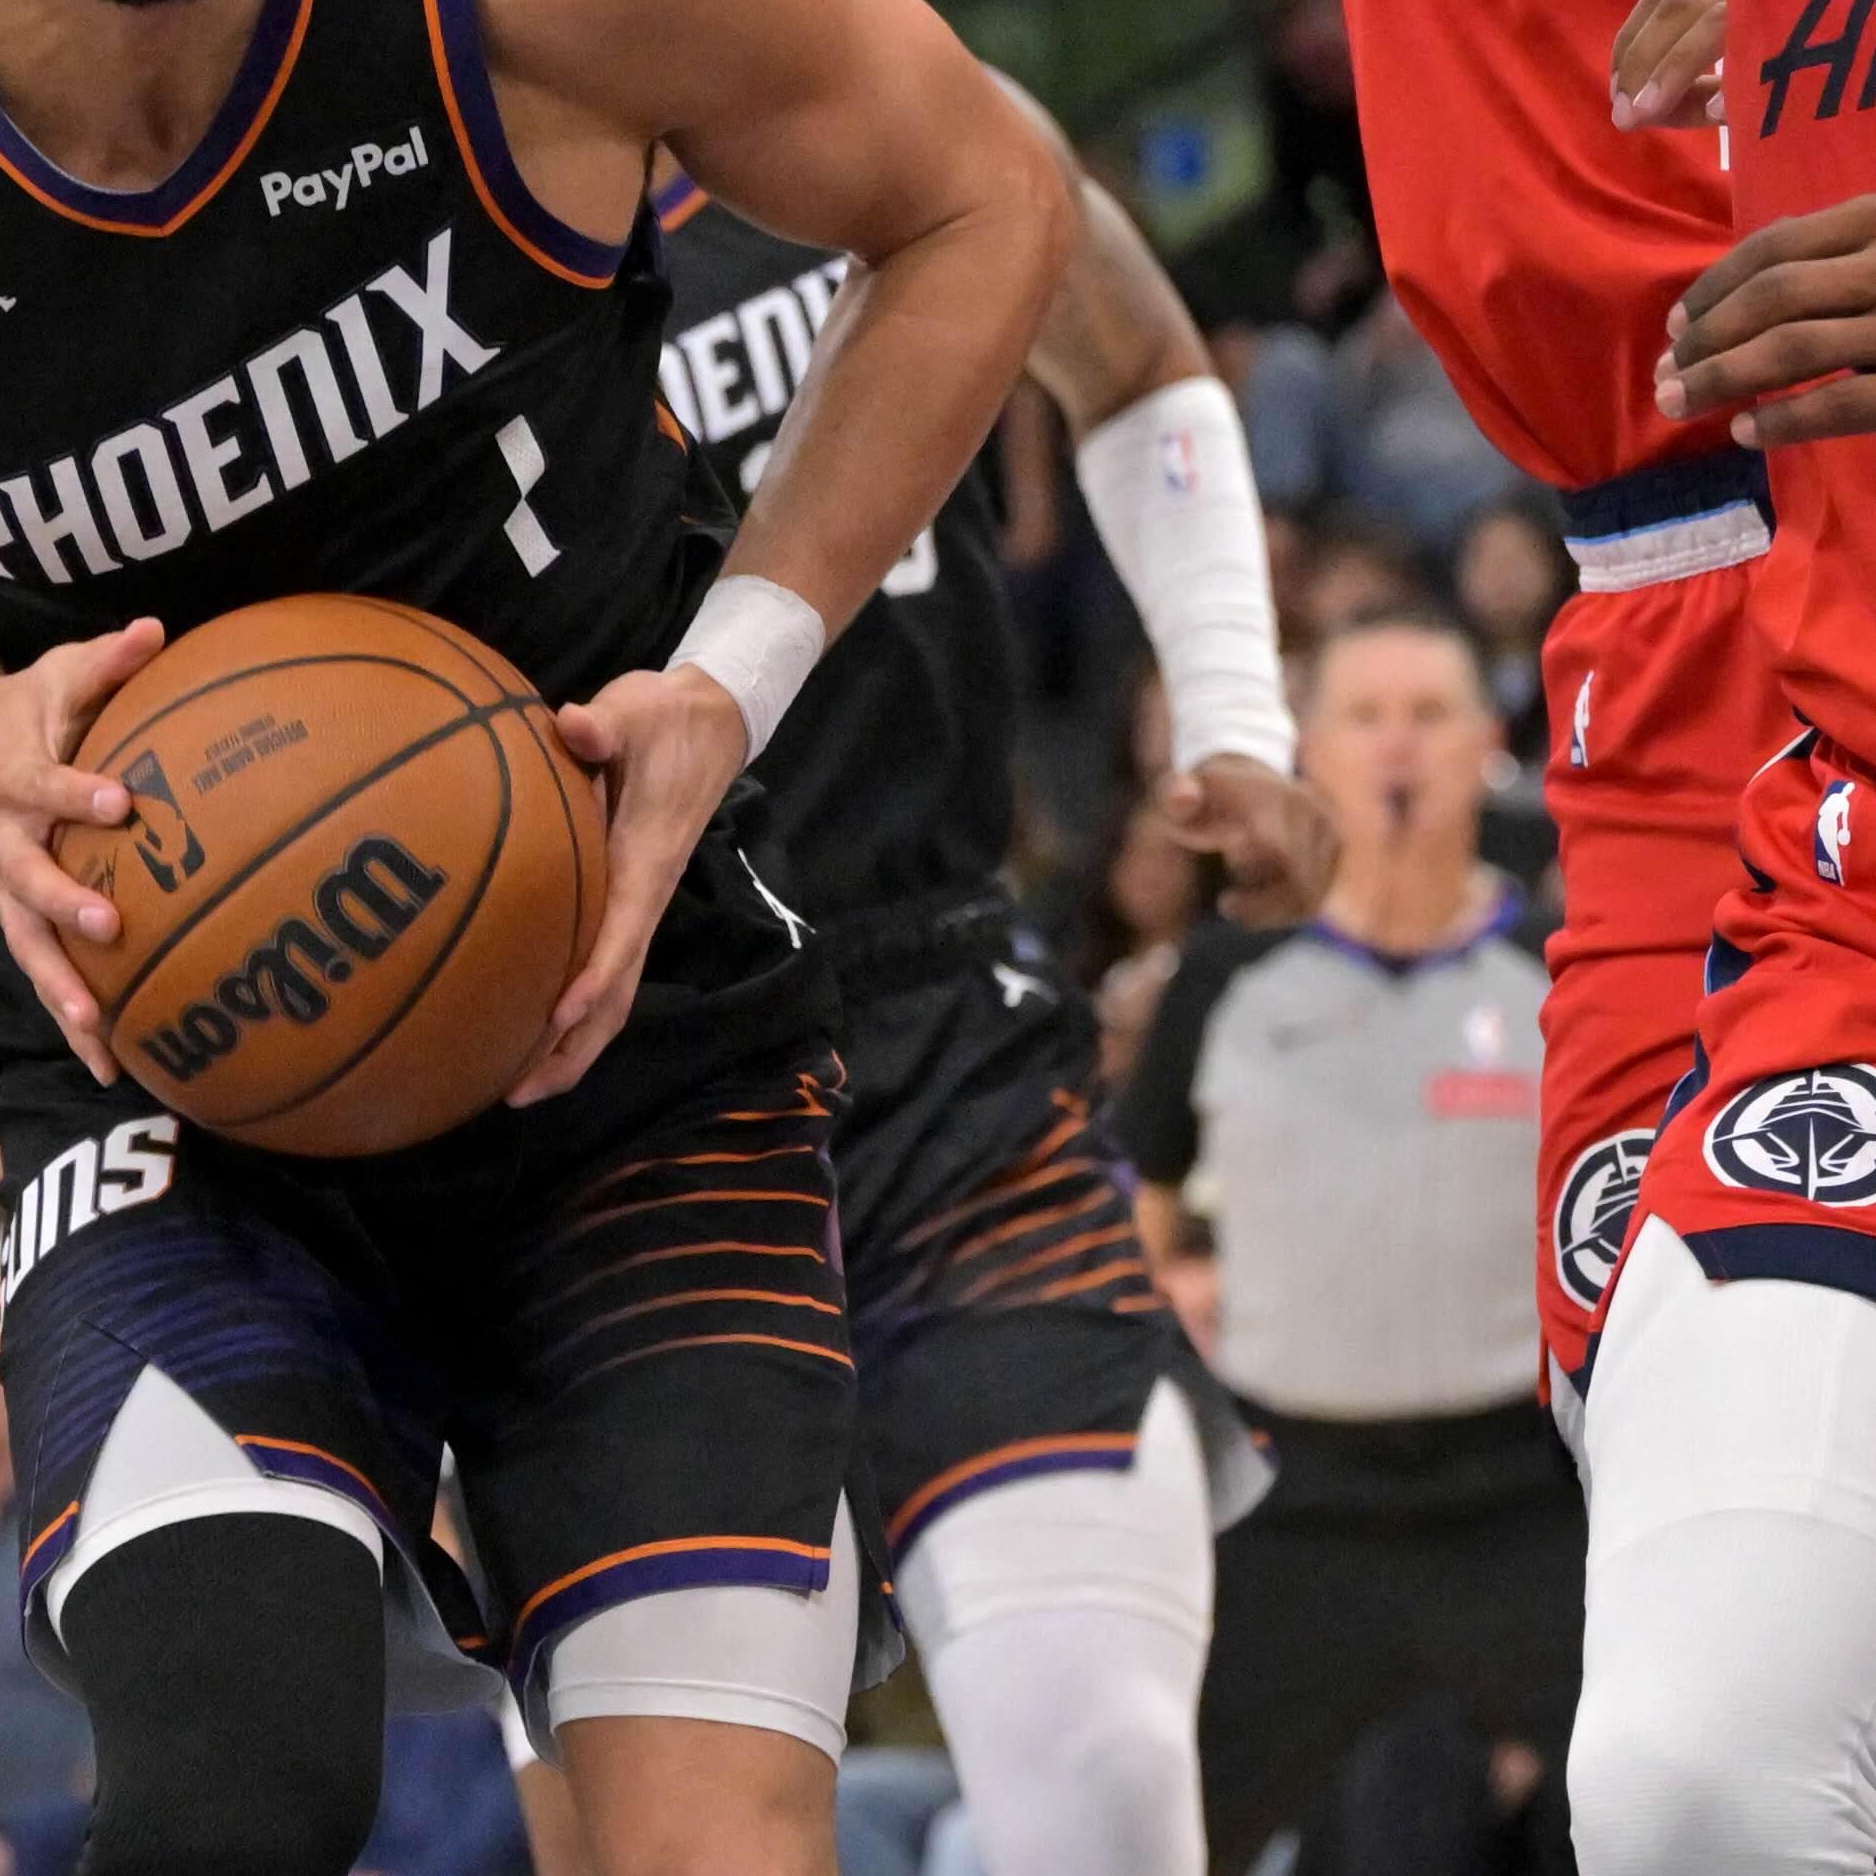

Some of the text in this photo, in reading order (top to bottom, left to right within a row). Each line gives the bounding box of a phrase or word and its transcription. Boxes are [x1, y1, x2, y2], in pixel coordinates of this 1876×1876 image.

[260, 126, 430, 216] PayPal
[494, 414, 563, 577] 1
[136, 835, 448, 1081] Wilson
[0, 1113, 180, 1335] UNS
